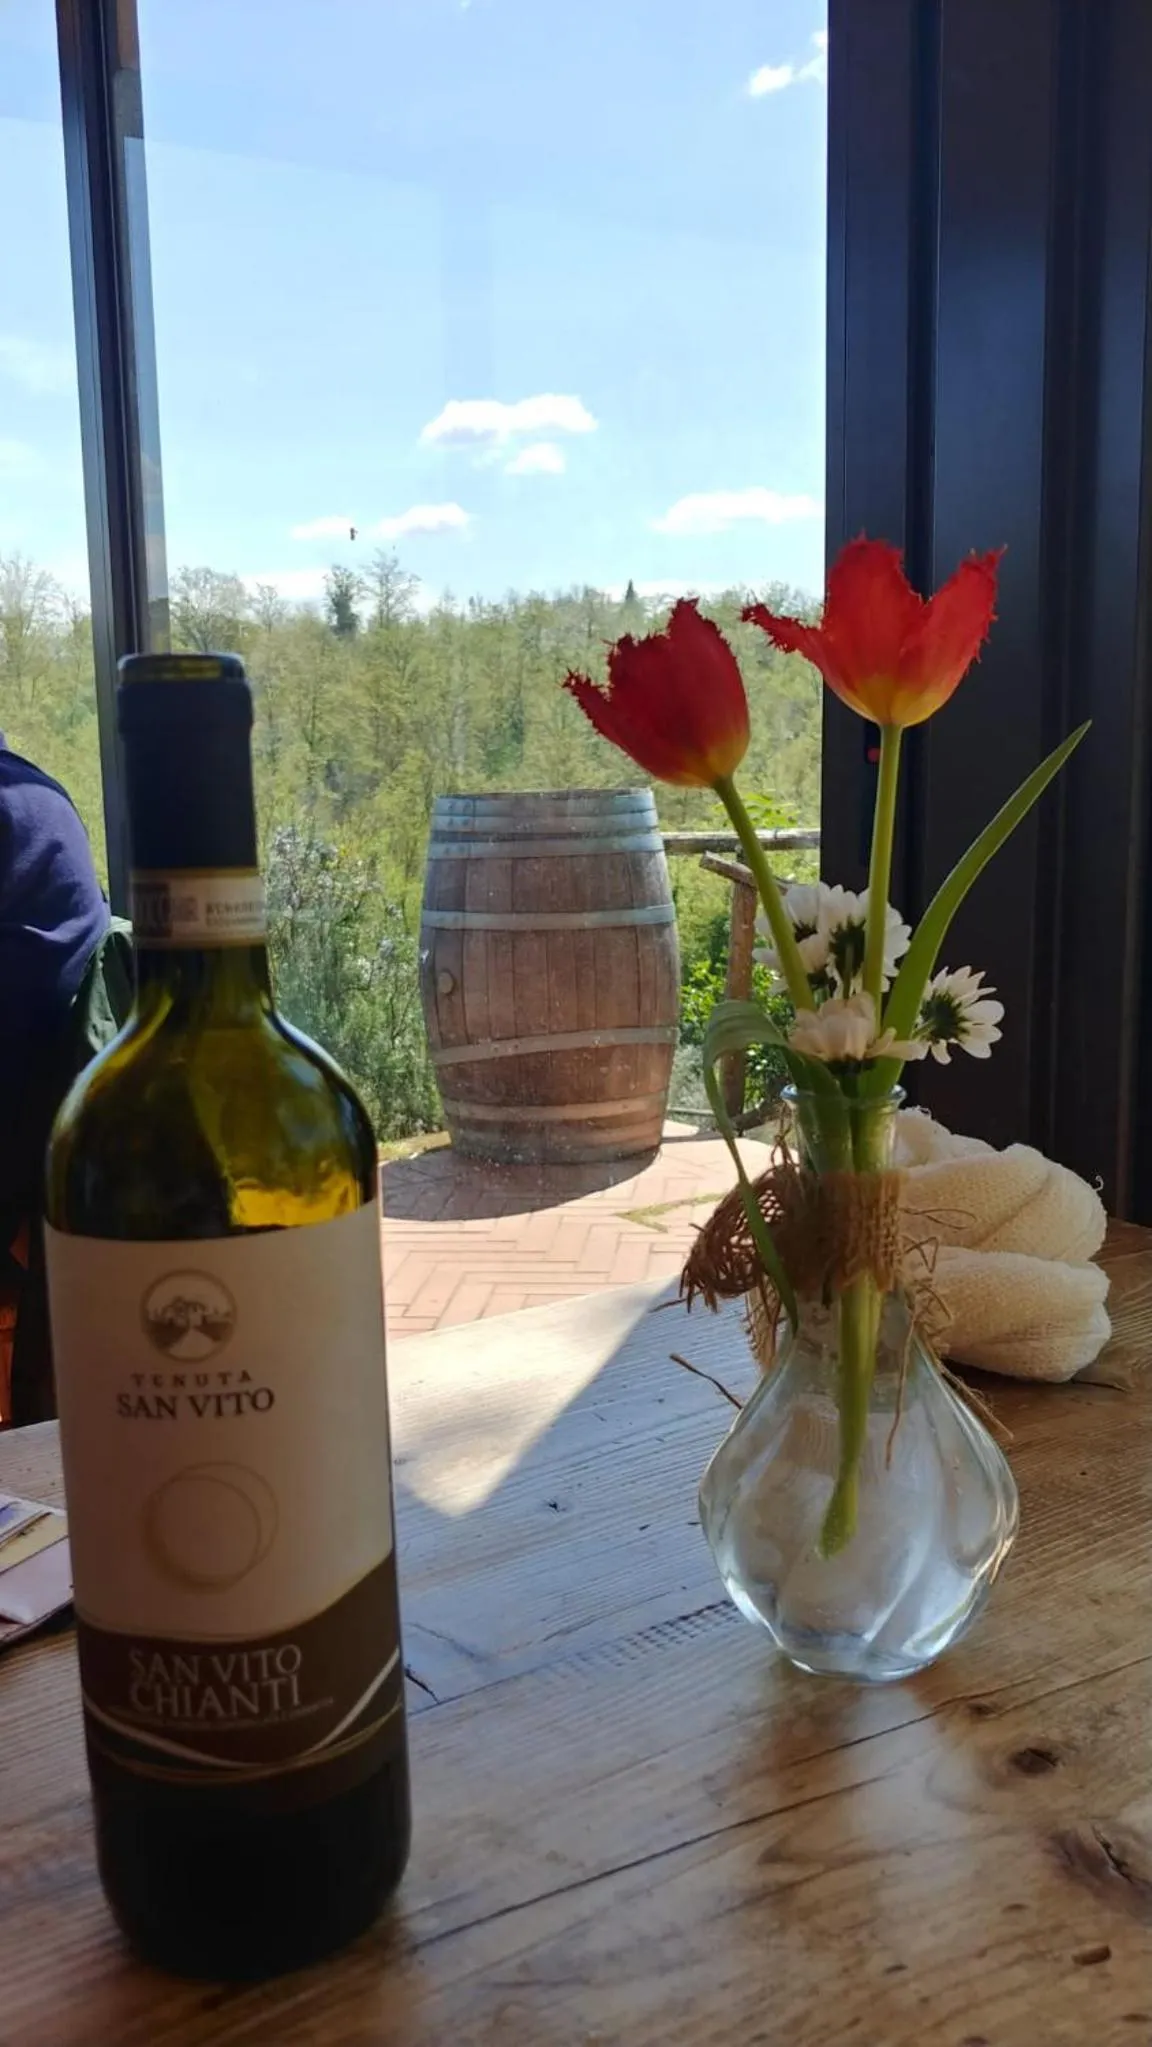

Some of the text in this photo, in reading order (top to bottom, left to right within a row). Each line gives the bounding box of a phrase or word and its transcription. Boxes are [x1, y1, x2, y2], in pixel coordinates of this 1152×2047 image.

[131, 1370, 253, 1388] TENUTA
[117, 1387, 275, 1420] SAN VITO
[129, 1644, 301, 1686] SAN VITO
[131, 1675, 301, 1718] CHIANTI
